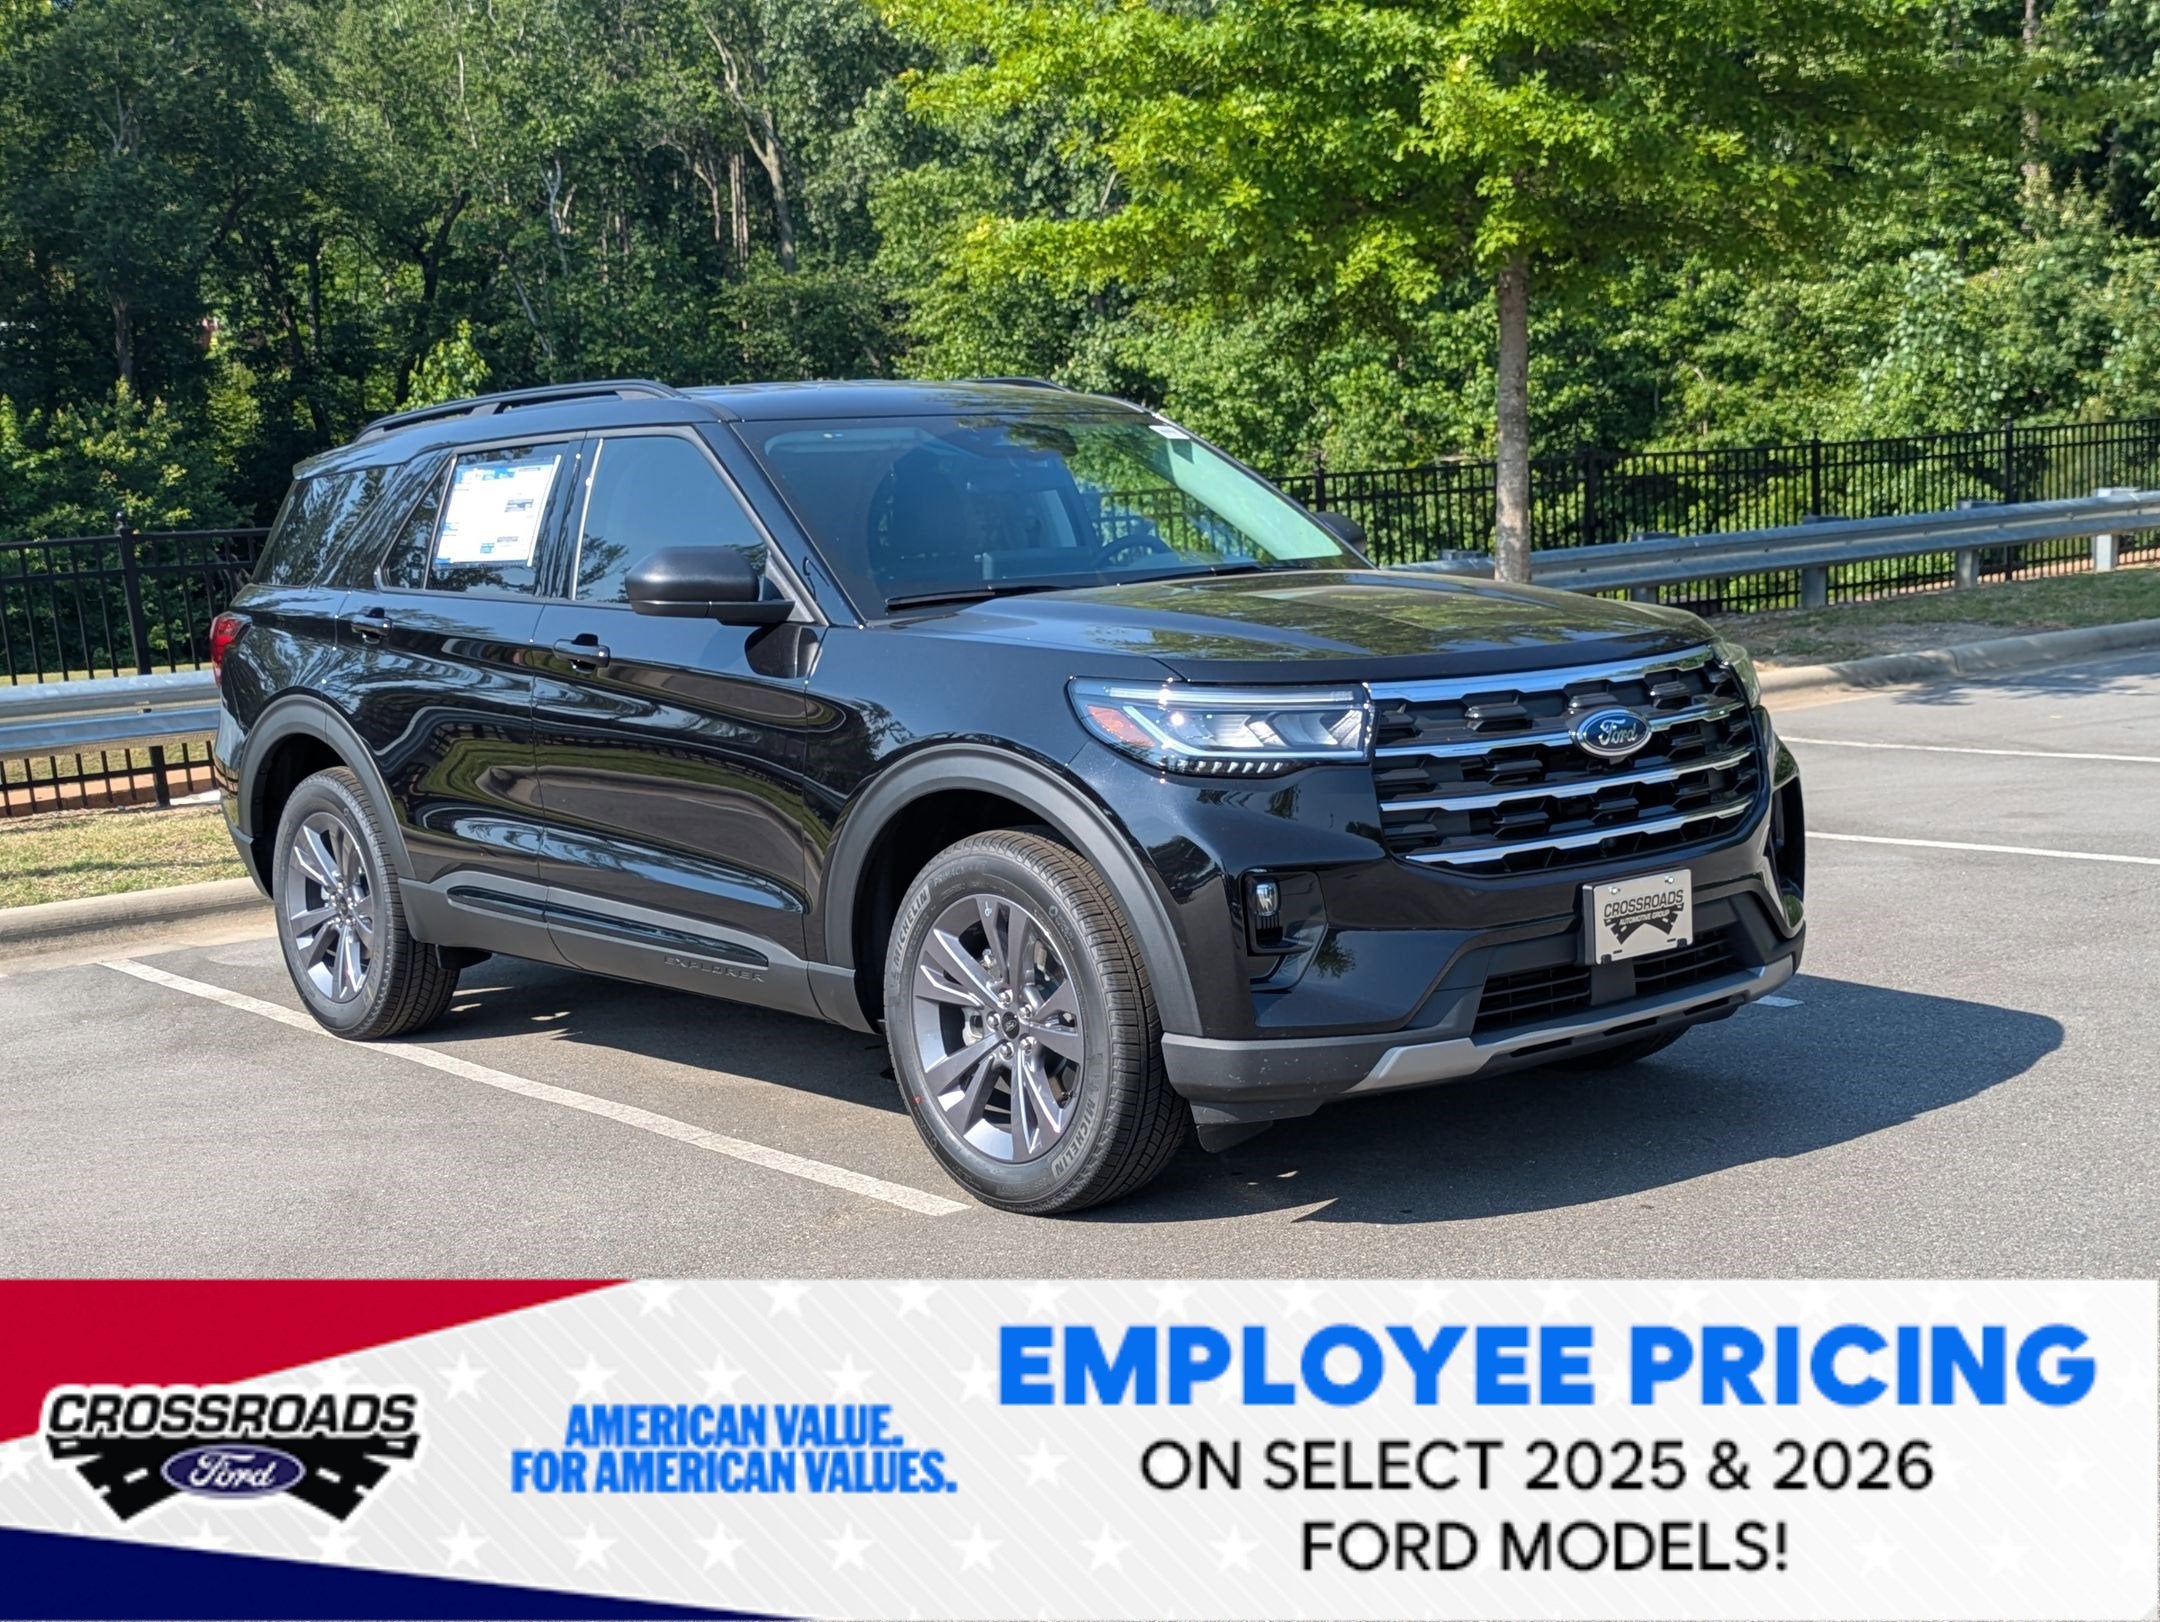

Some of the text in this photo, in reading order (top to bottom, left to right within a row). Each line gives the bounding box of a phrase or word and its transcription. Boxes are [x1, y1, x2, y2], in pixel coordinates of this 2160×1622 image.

[1598, 719, 1638, 746] Ford
[1604, 889, 1684, 918] CROSSROADS
[1619, 909, 1671, 926] AUTOMOTIVE GROUP
[893, 889, 929, 969] MICHELIN
[664, 955, 765, 983] EXPLORER
[1055, 1097, 1096, 1177] MICHELIN
